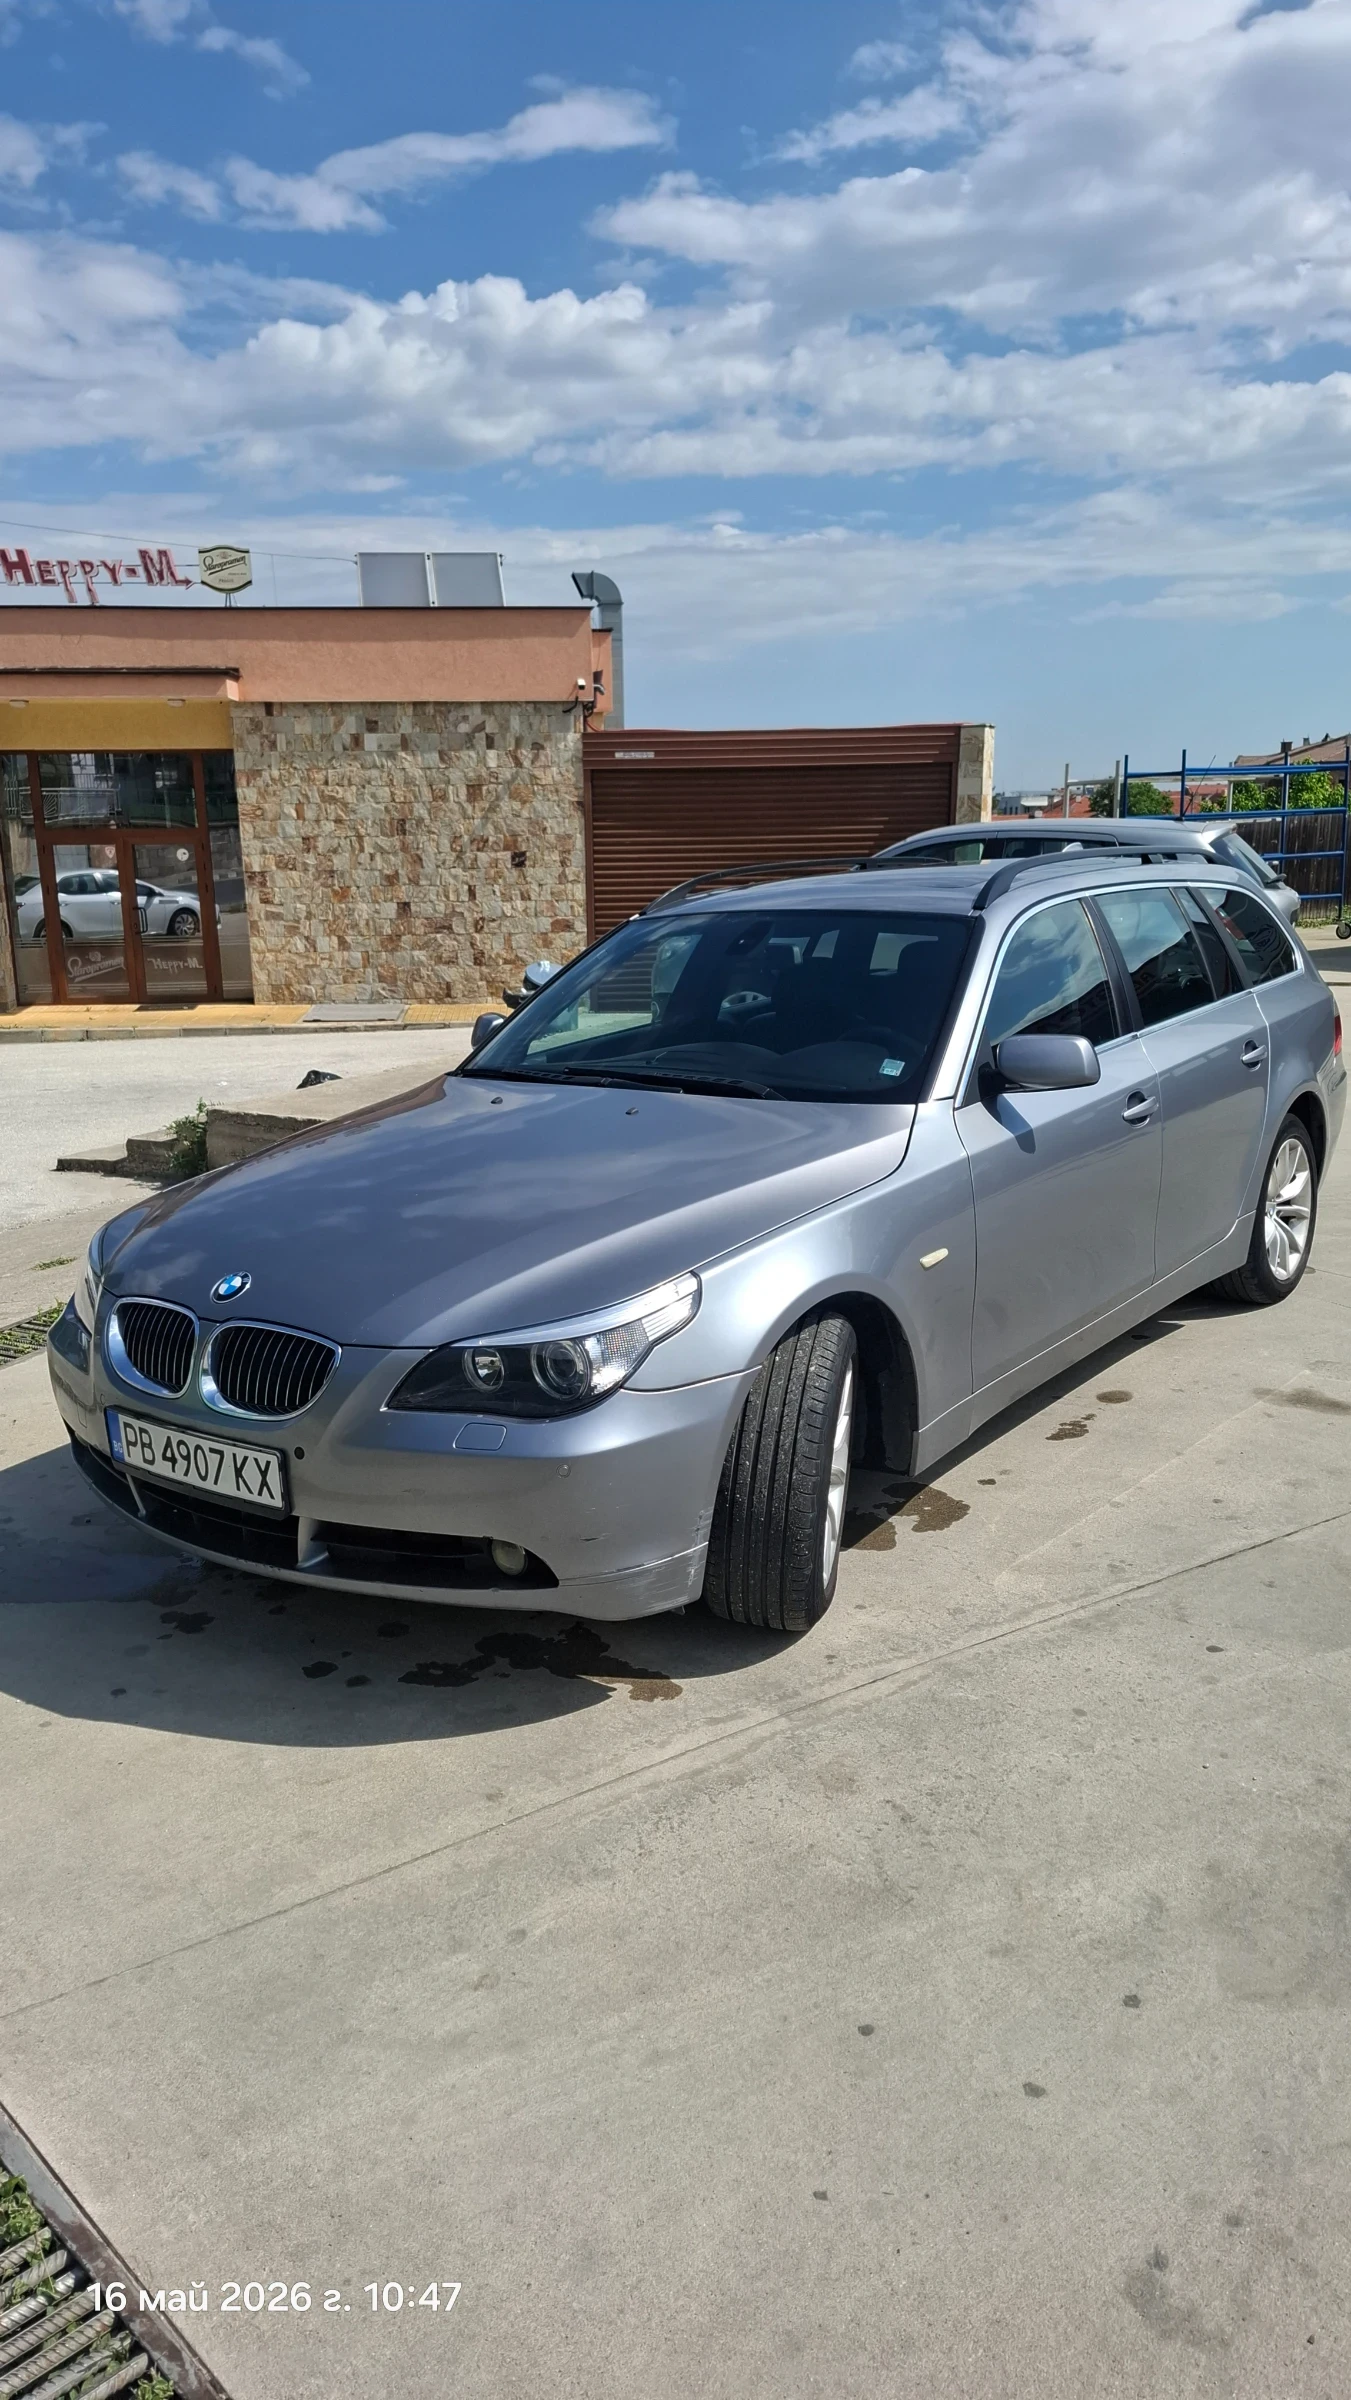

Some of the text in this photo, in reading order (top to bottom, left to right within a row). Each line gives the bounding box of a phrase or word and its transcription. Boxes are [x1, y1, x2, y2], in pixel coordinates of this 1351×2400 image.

[203, 555, 247, 573] Staropramen
[67, 956, 126, 979] Staropramen
[113, 1440, 123, 1453] BG
[123, 1421, 276, 1500] PB 4907 KX
